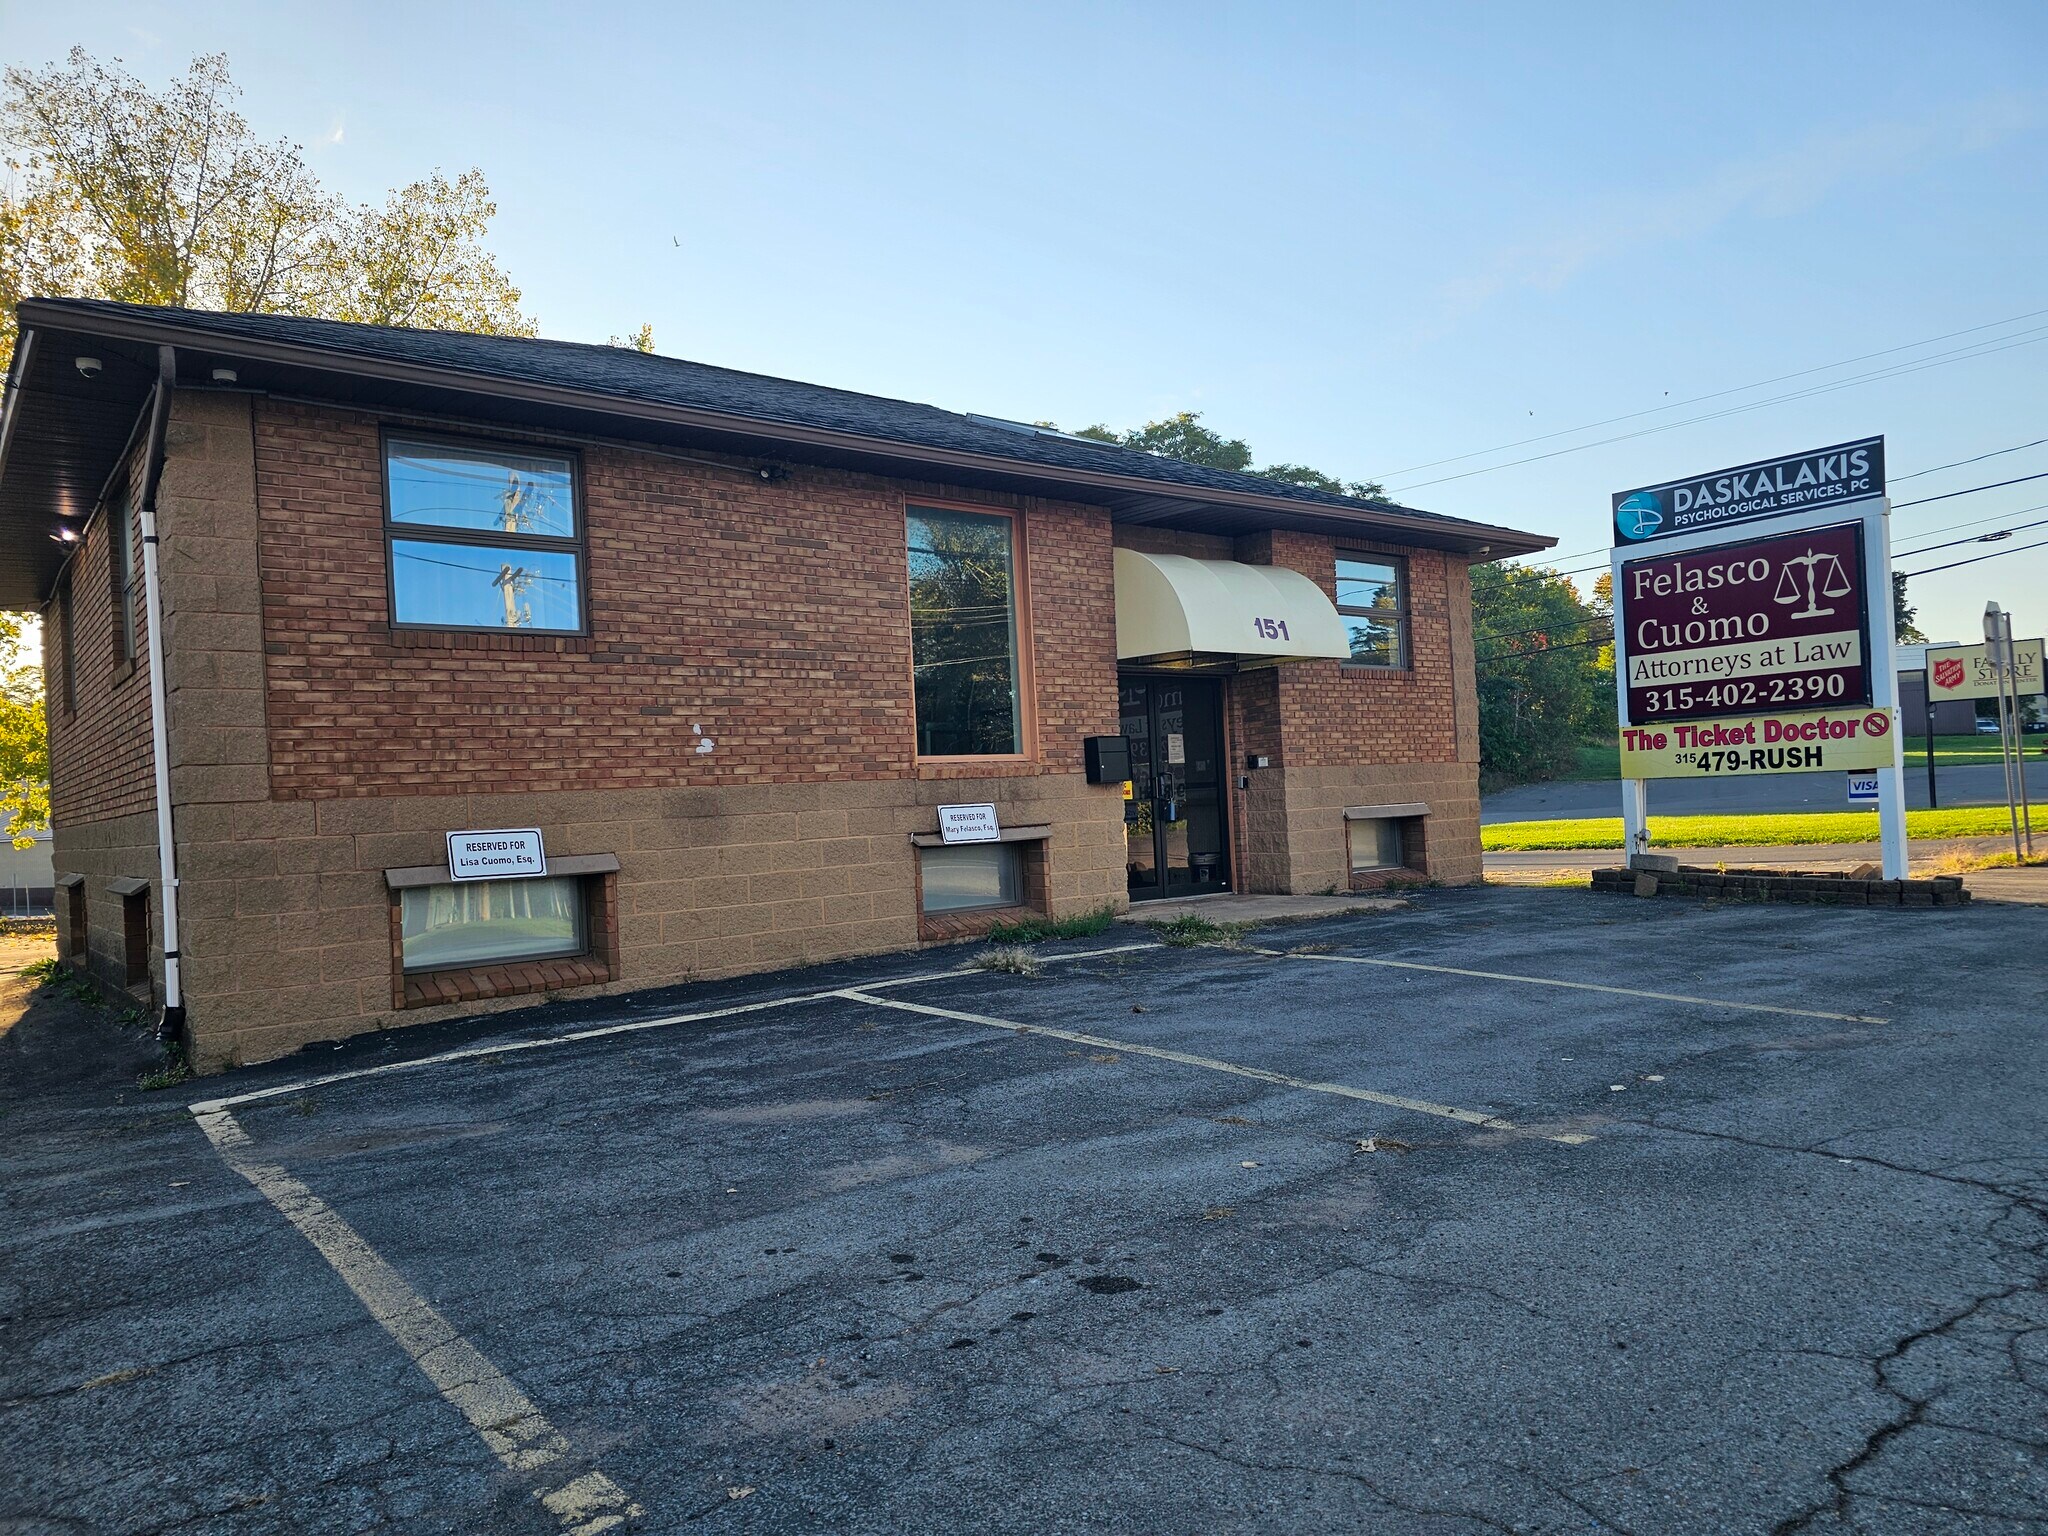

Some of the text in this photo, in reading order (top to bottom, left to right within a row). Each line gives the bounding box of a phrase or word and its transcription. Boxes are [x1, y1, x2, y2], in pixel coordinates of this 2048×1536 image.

[1674, 449, 1870, 513] DASKALAKIS
[1674, 478, 1870, 526] PSYCHOLOGICAL SERVICES, PC
[1633, 556, 1770, 600] Felasco
[1691, 596, 1710, 615] &
[1254, 617, 1290, 641] 151
[1637, 612, 1770, 650] Cuomo
[1633, 640, 1852, 680] Attorneys at Law
[1939, 661, 1951, 672] THE
[1645, 673, 1846, 712] 315-402-2390
[1623, 716, 1861, 752] The Ticket Doctor
[1675, 745, 1824, 772] 315 479-RUSH
[1853, 781, 1878, 791] VISA
[946, 825, 959, 833] Mary
[466, 841, 526, 852] RESERVED FOR
[460, 855, 535, 866] Lisa Cuomo, Esq.
